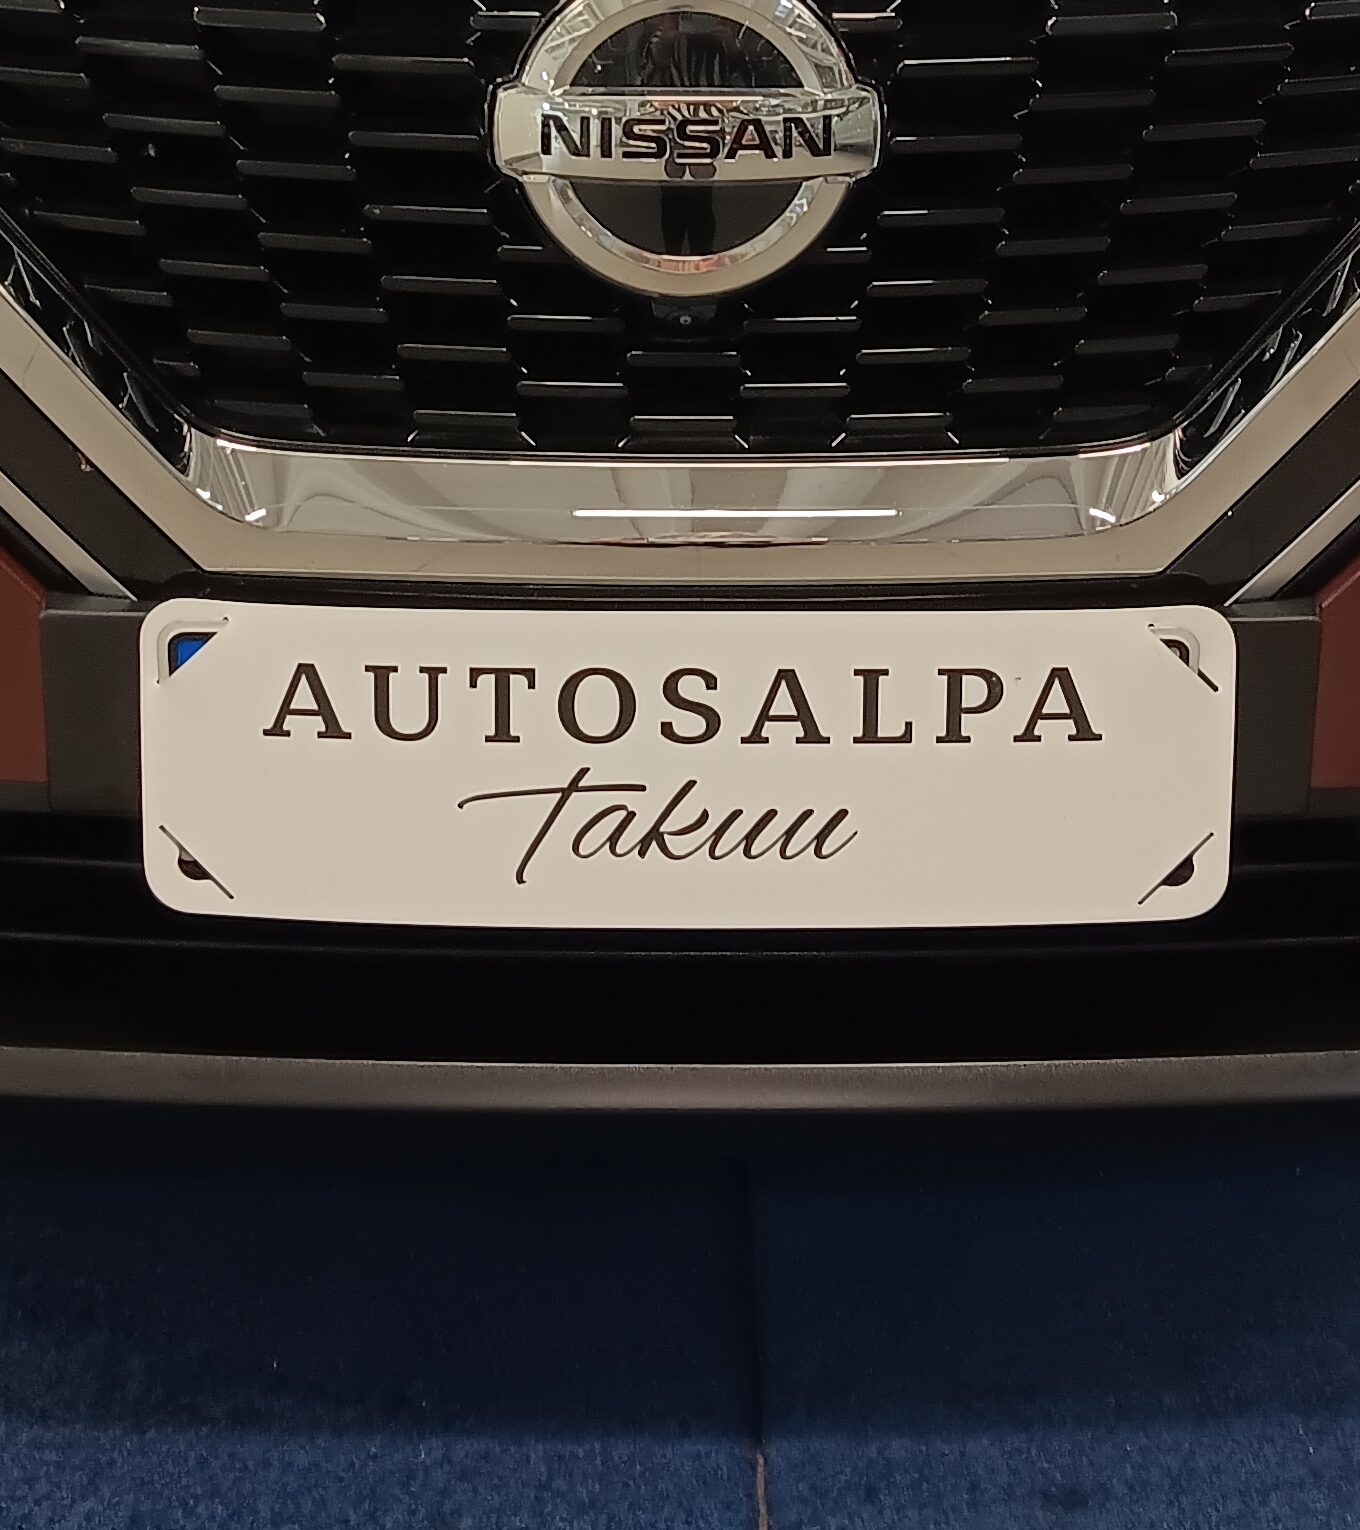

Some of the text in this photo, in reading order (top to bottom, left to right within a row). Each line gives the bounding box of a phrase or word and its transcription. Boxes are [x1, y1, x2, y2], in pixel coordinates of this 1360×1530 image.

[539, 114, 833, 162] NISSAN
[262, 662, 1103, 745] AUTOSALPA
[457, 766, 858, 885] Takuu
